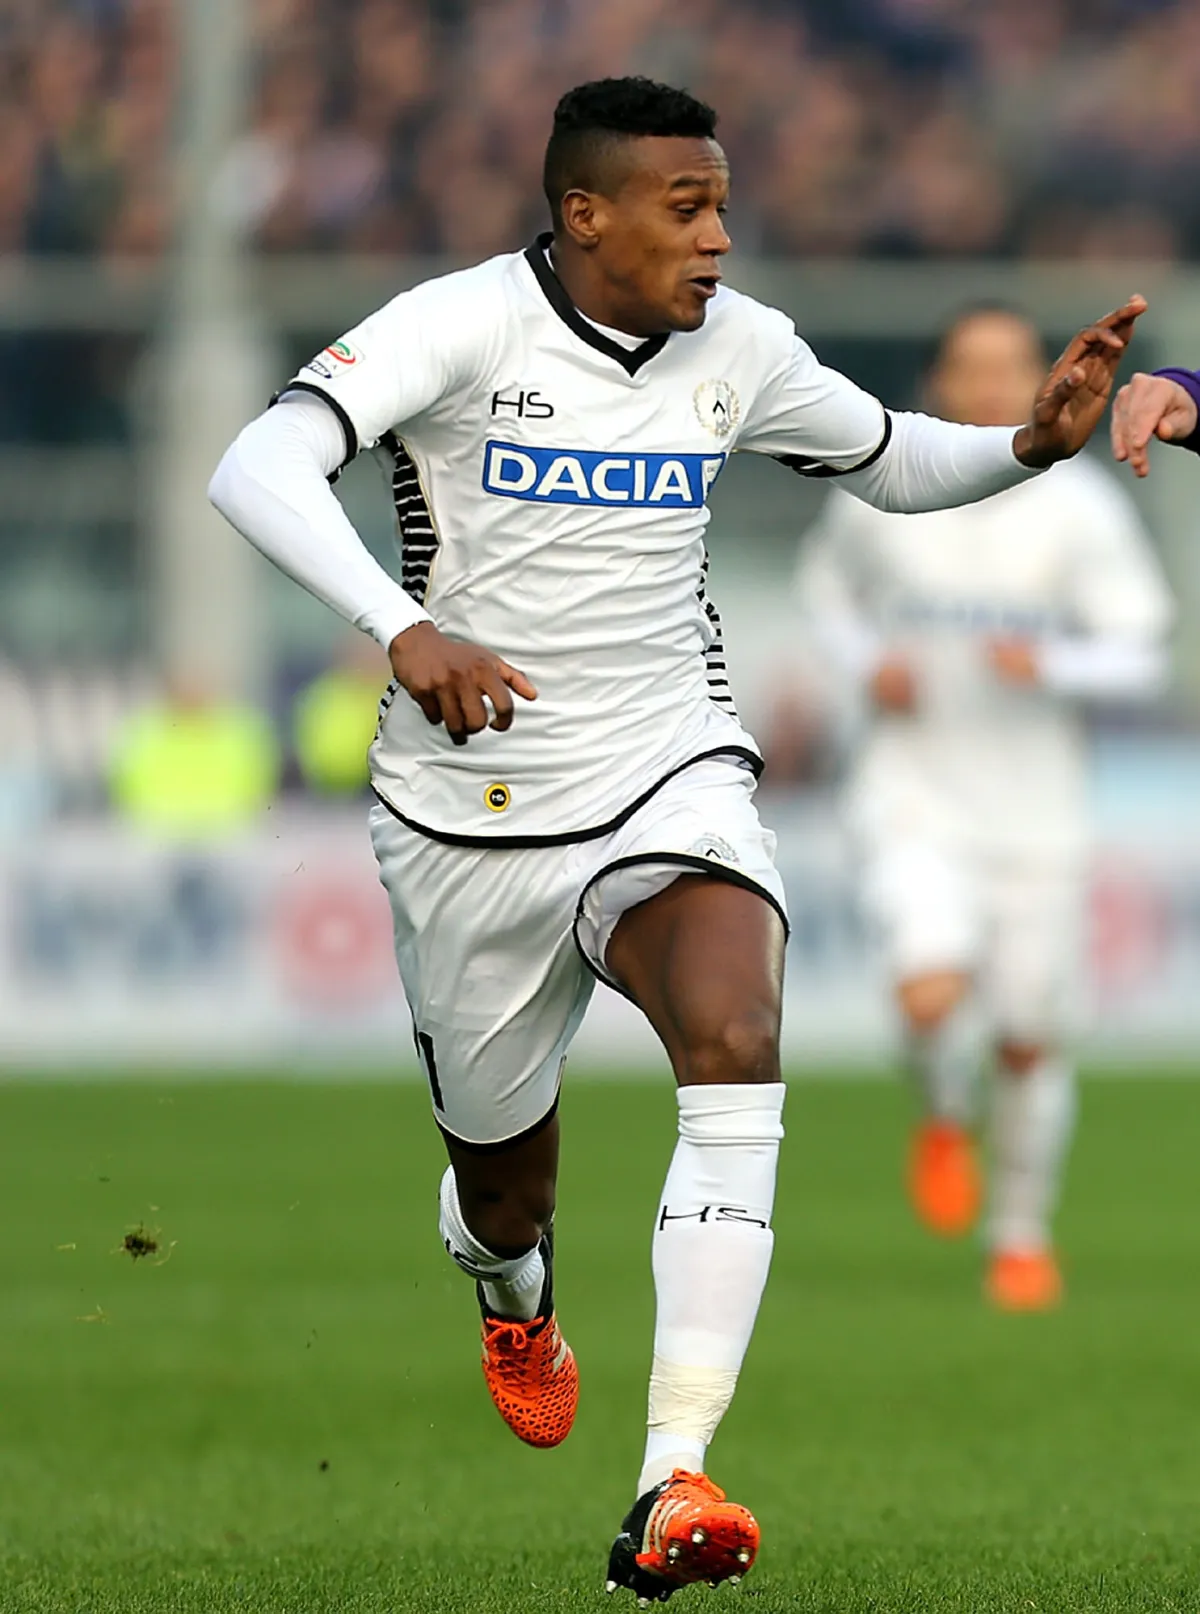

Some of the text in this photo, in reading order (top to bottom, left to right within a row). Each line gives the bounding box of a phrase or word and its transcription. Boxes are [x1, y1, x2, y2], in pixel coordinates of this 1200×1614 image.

[491, 391, 554, 418] HS
[488, 447, 693, 502] DACIA
[659, 1205, 767, 1231] HS
